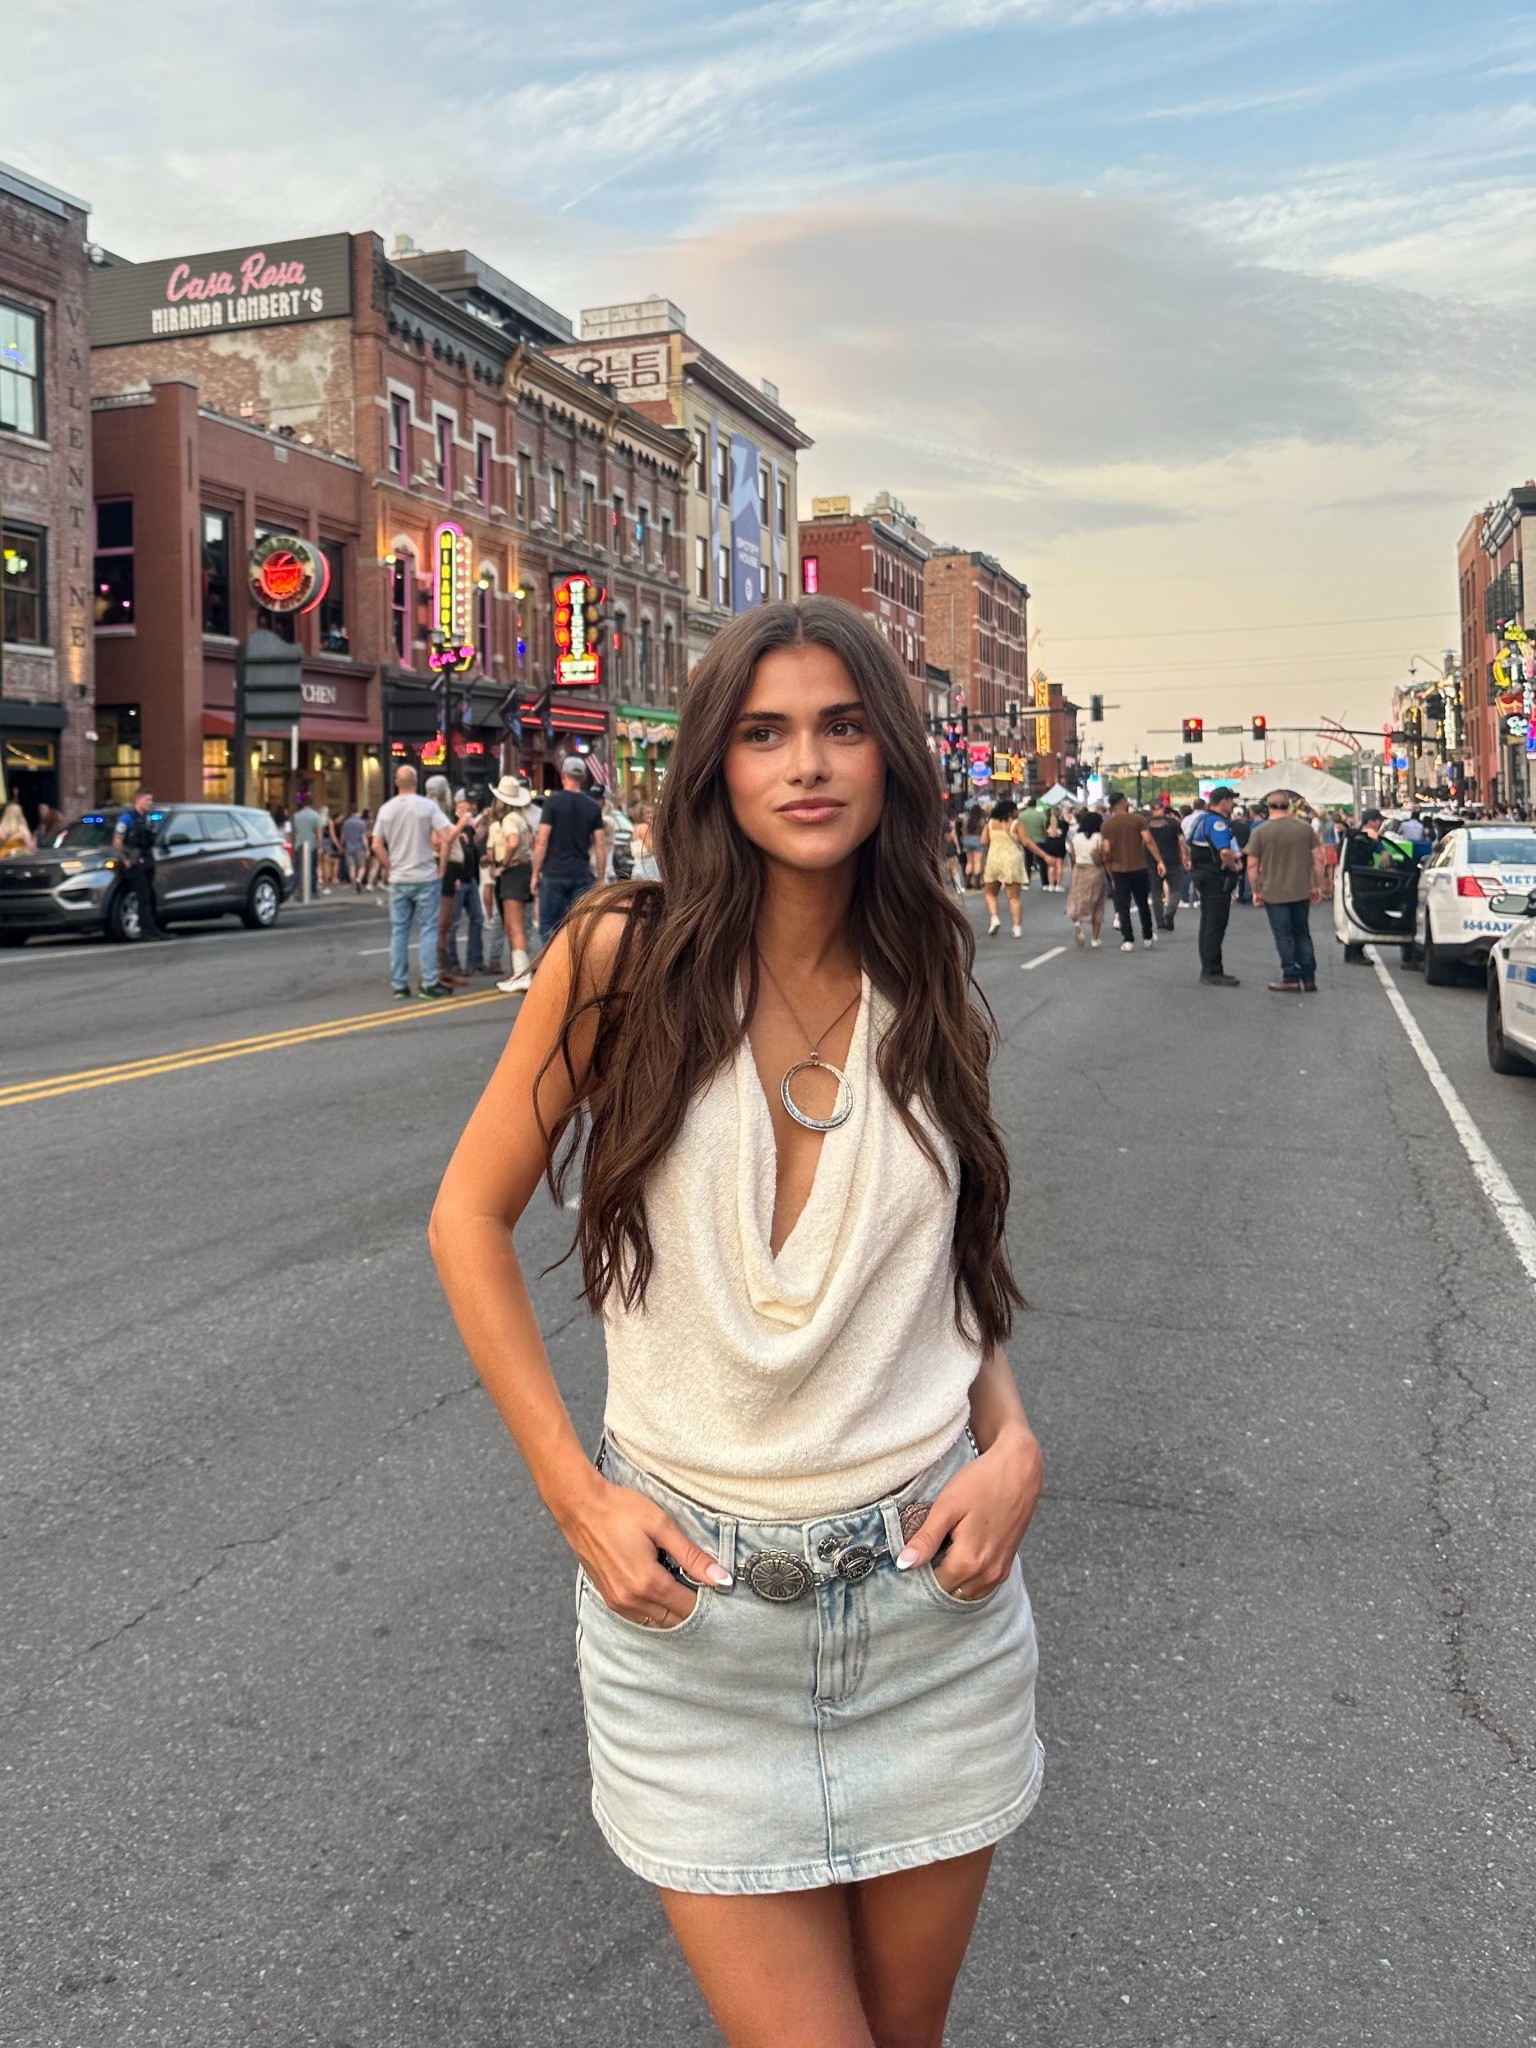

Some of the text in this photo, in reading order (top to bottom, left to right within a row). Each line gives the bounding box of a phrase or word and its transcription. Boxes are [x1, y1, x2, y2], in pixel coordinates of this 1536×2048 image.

[166, 252, 306, 302] Casa Rosa
[152, 287, 323, 334] MIRANDA LAMBERT'S
[577, 351, 660, 373] OLE
[66, 304, 86, 648] VALENTINE
[736, 536, 759, 556] SPOTIFY
[738, 550, 758, 569] HOUSE
